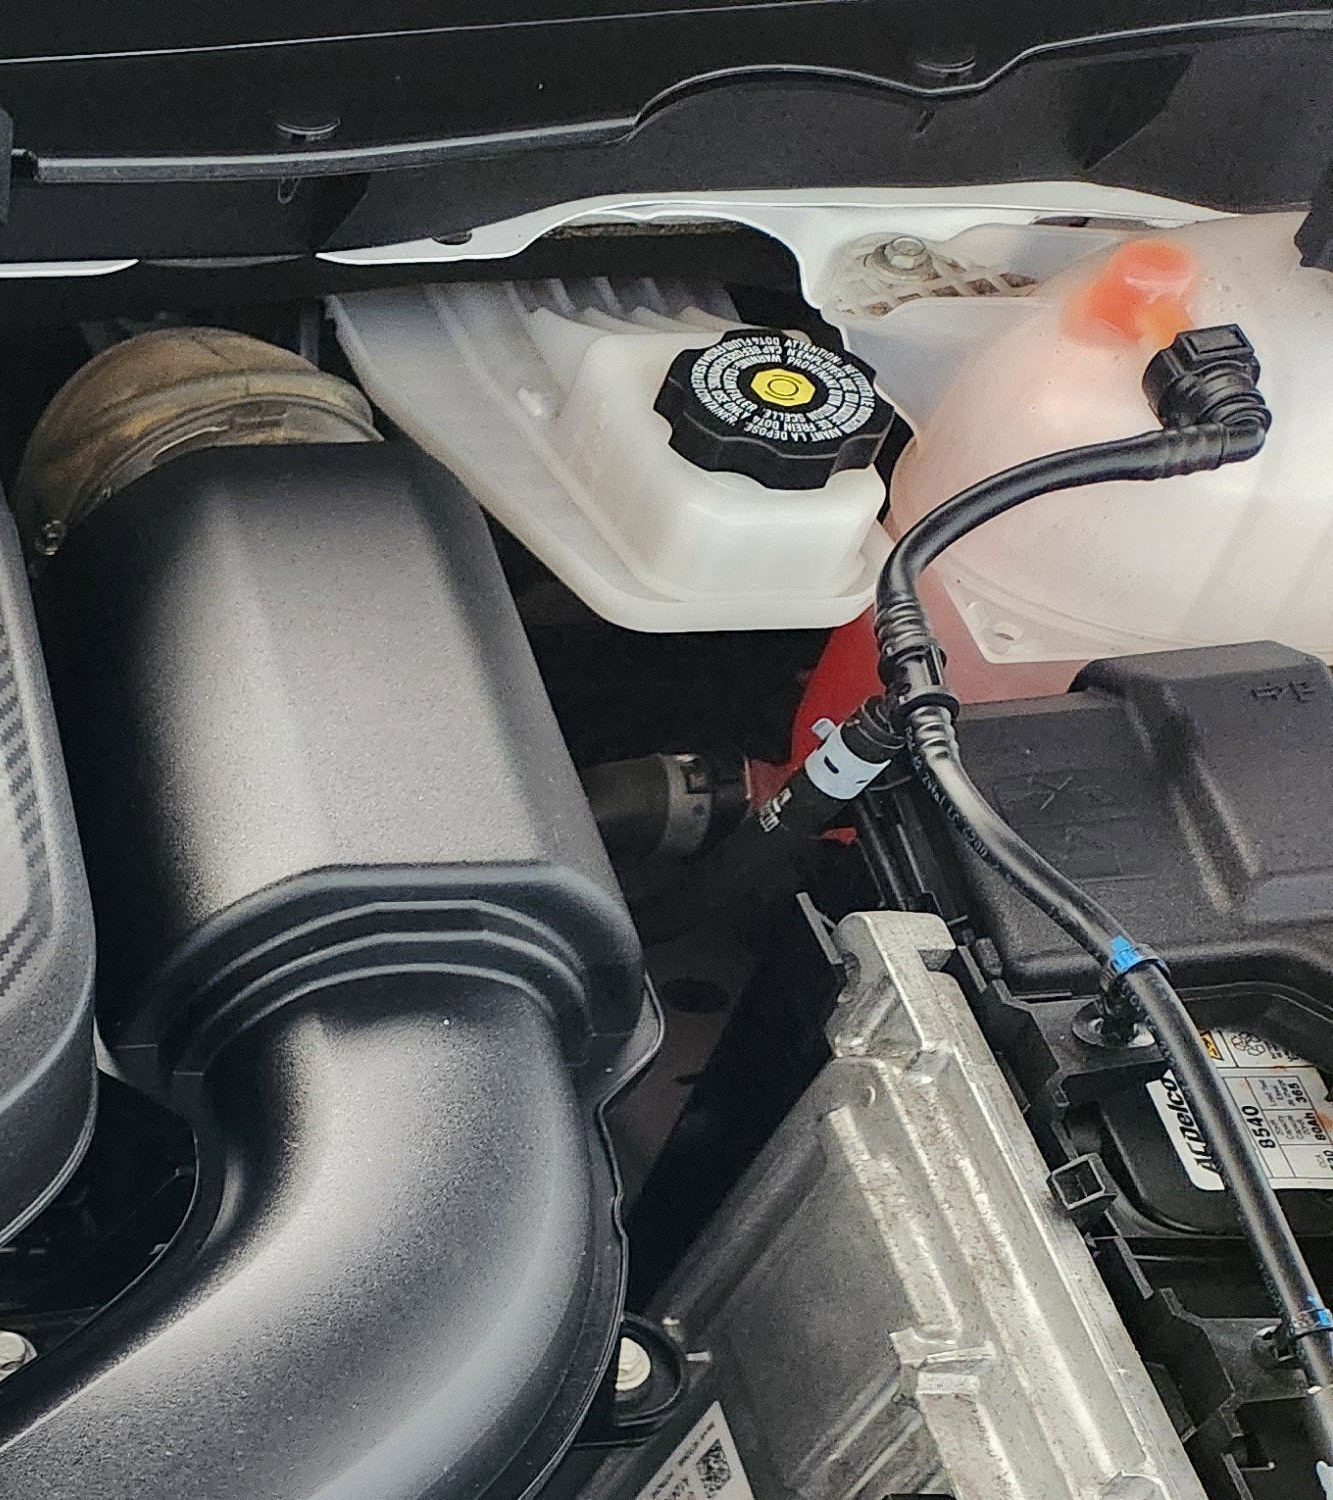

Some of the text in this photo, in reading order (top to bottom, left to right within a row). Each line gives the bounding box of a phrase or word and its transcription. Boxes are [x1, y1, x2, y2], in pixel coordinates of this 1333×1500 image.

[1288, 1083, 1307, 1103] 365
[1241, 1105, 1276, 1149] 8540
[1303, 1112, 1326, 1140] 80Ah
